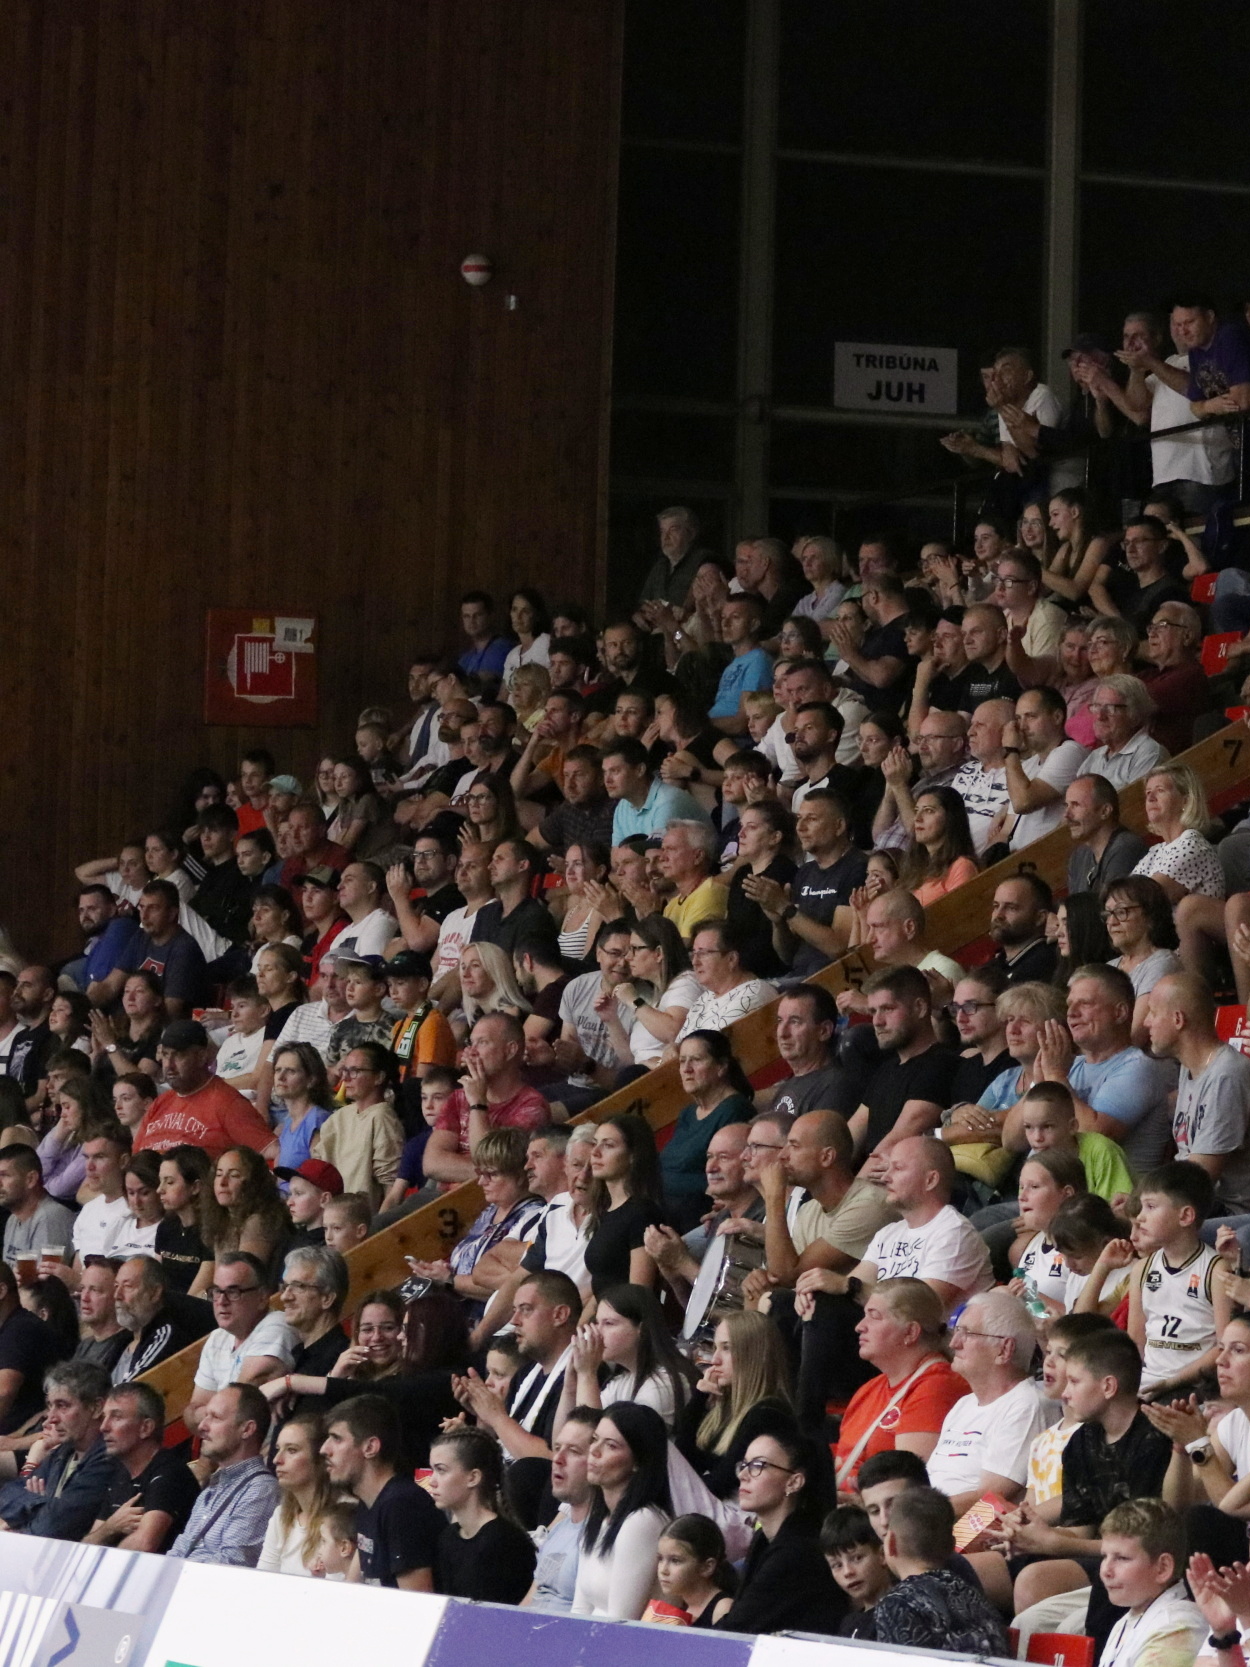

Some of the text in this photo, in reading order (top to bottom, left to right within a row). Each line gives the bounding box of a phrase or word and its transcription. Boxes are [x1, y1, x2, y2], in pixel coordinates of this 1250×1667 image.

[853, 353, 940, 372] TRIBÚNA
[867, 380, 926, 403] JUH
[1222, 738, 1243, 768] 7
[437, 1207, 460, 1239] 3
[1161, 1314, 1183, 1339] 12
